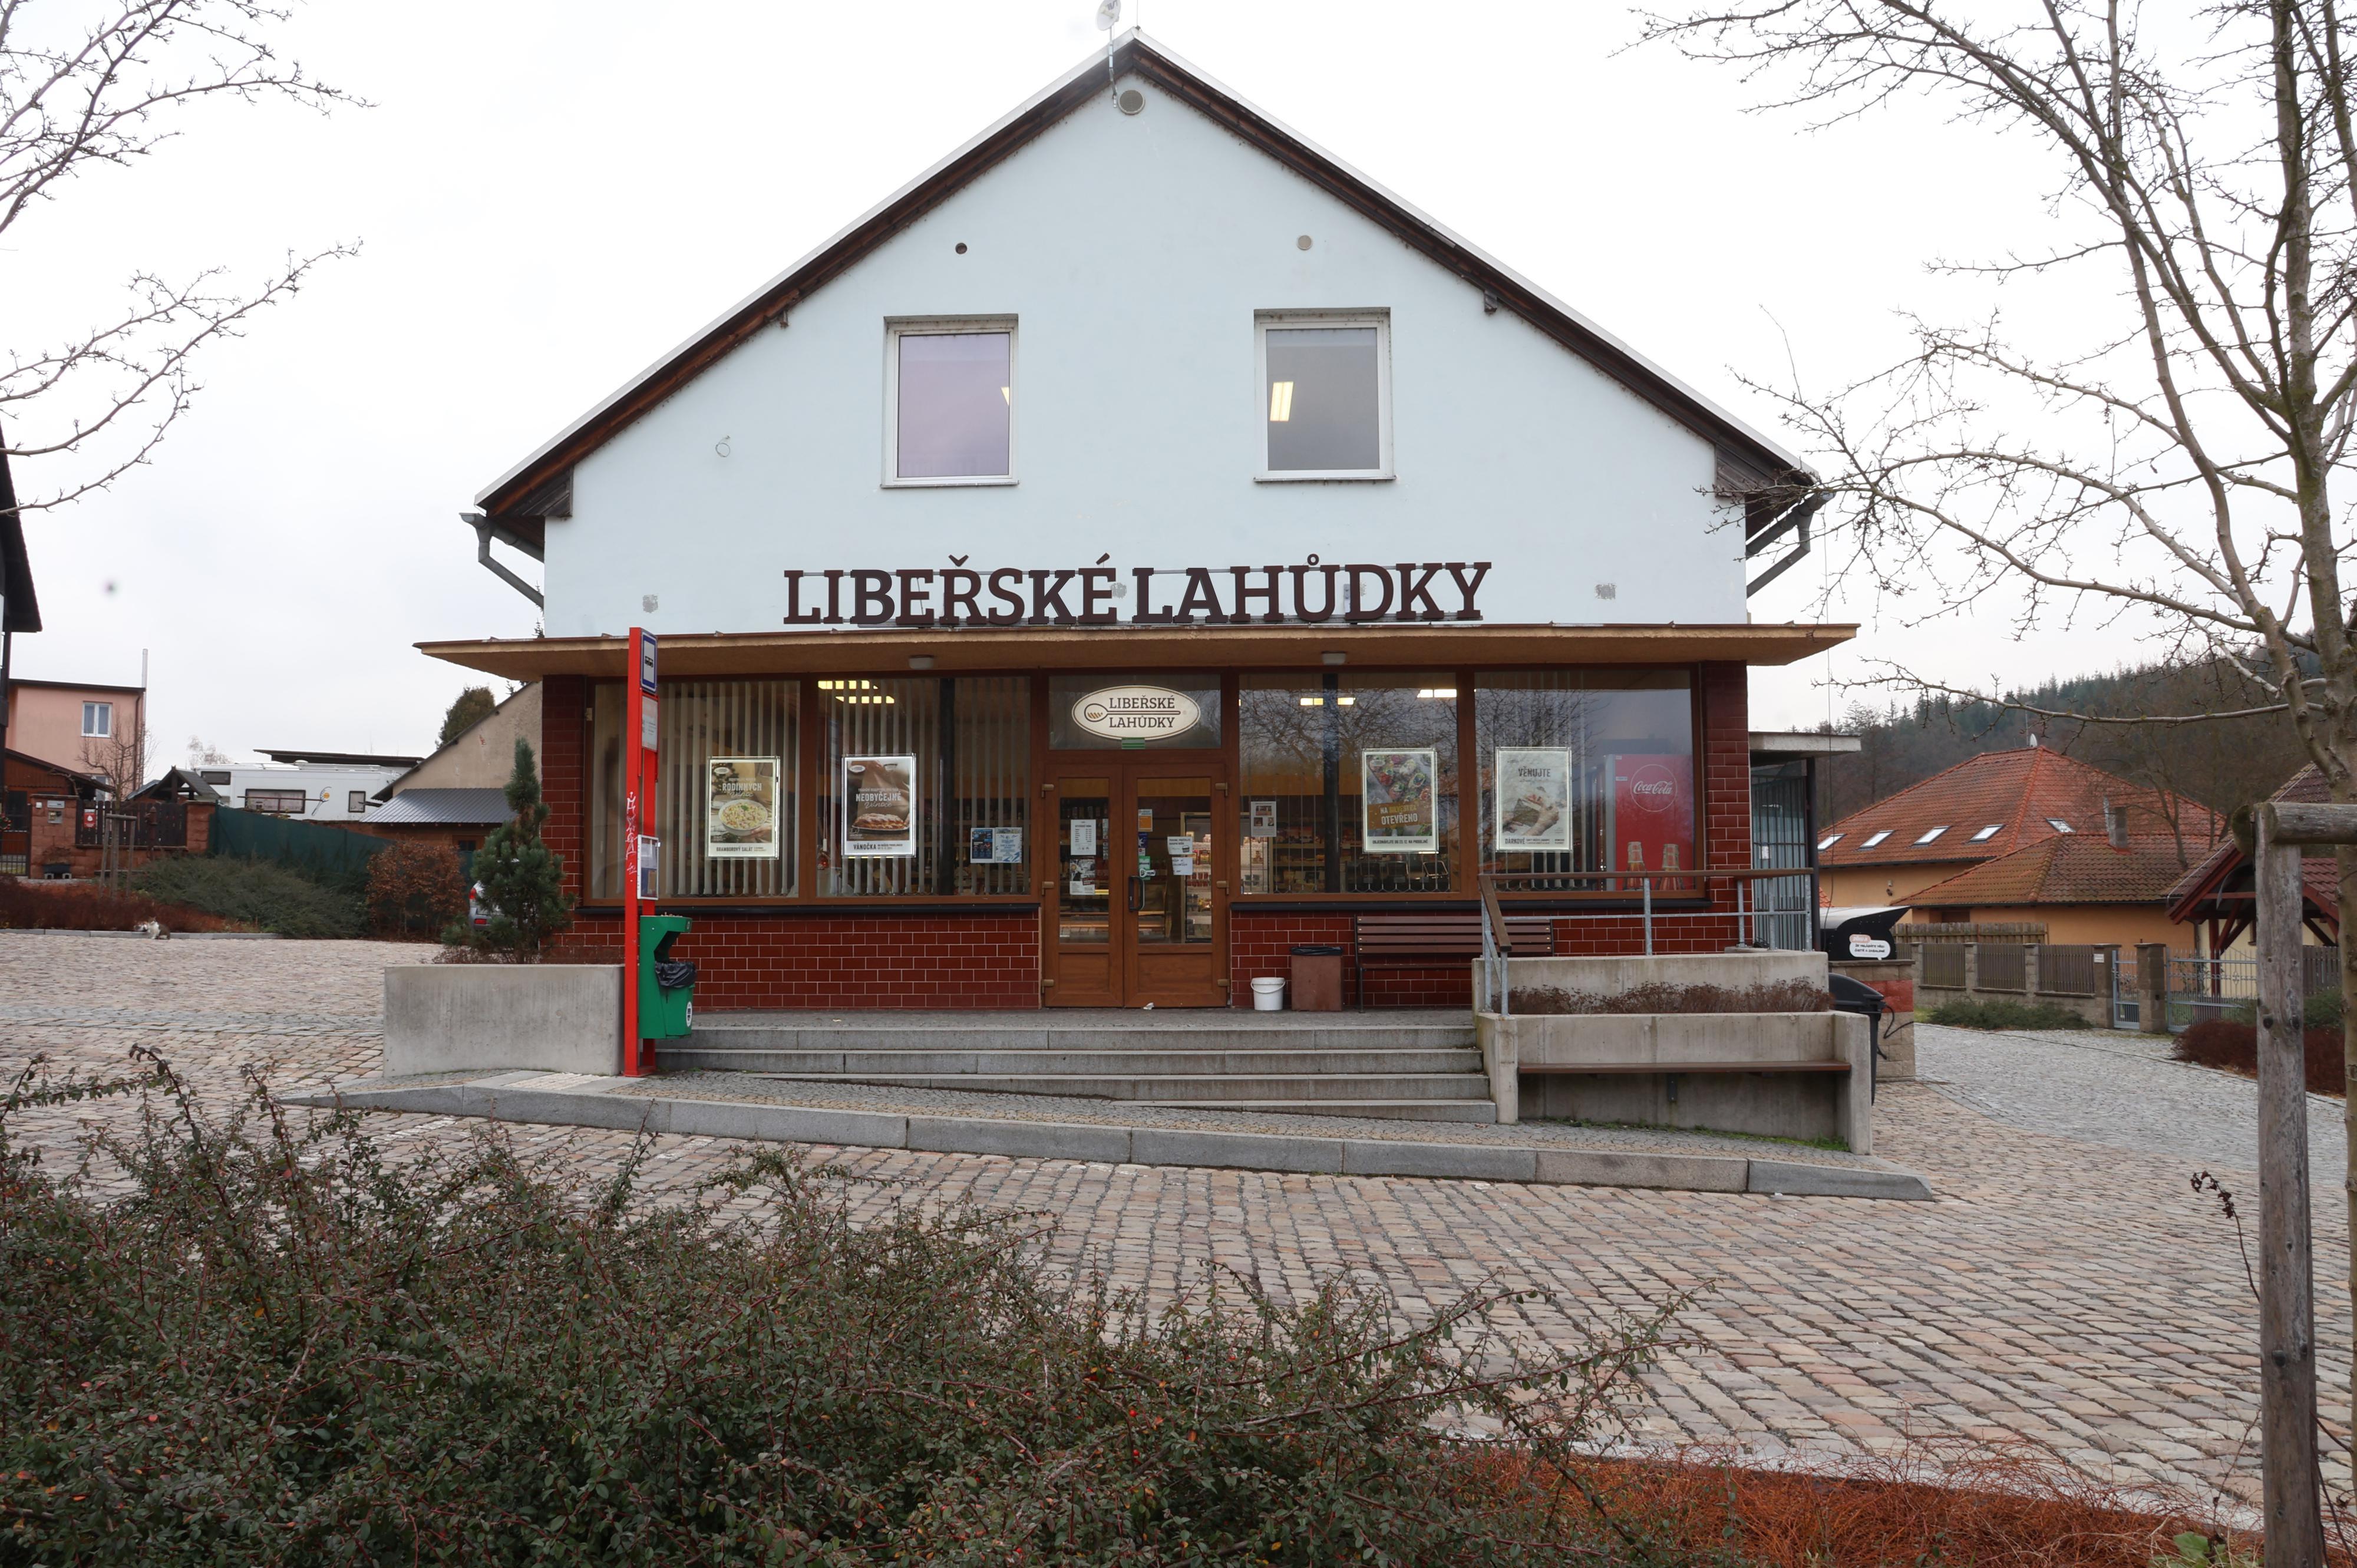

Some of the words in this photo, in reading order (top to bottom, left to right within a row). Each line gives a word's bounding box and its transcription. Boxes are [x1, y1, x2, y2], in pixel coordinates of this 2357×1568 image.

[784, 553, 1117, 625] LIBEŘSKÉ
[1132, 553, 1492, 624] LAHŮDKY
[1109, 695, 1175, 709] LIBEŘSKÉ
[1109, 715, 1175, 728] LAHŮDKY
[1518, 766, 1551, 777] VĚNUJTE
[1633, 780, 1673, 794] Coca-Cola
[856, 791, 902, 801] NEOBYČEJNÉ
[1381, 813, 1418, 825] OTEVŘENO
